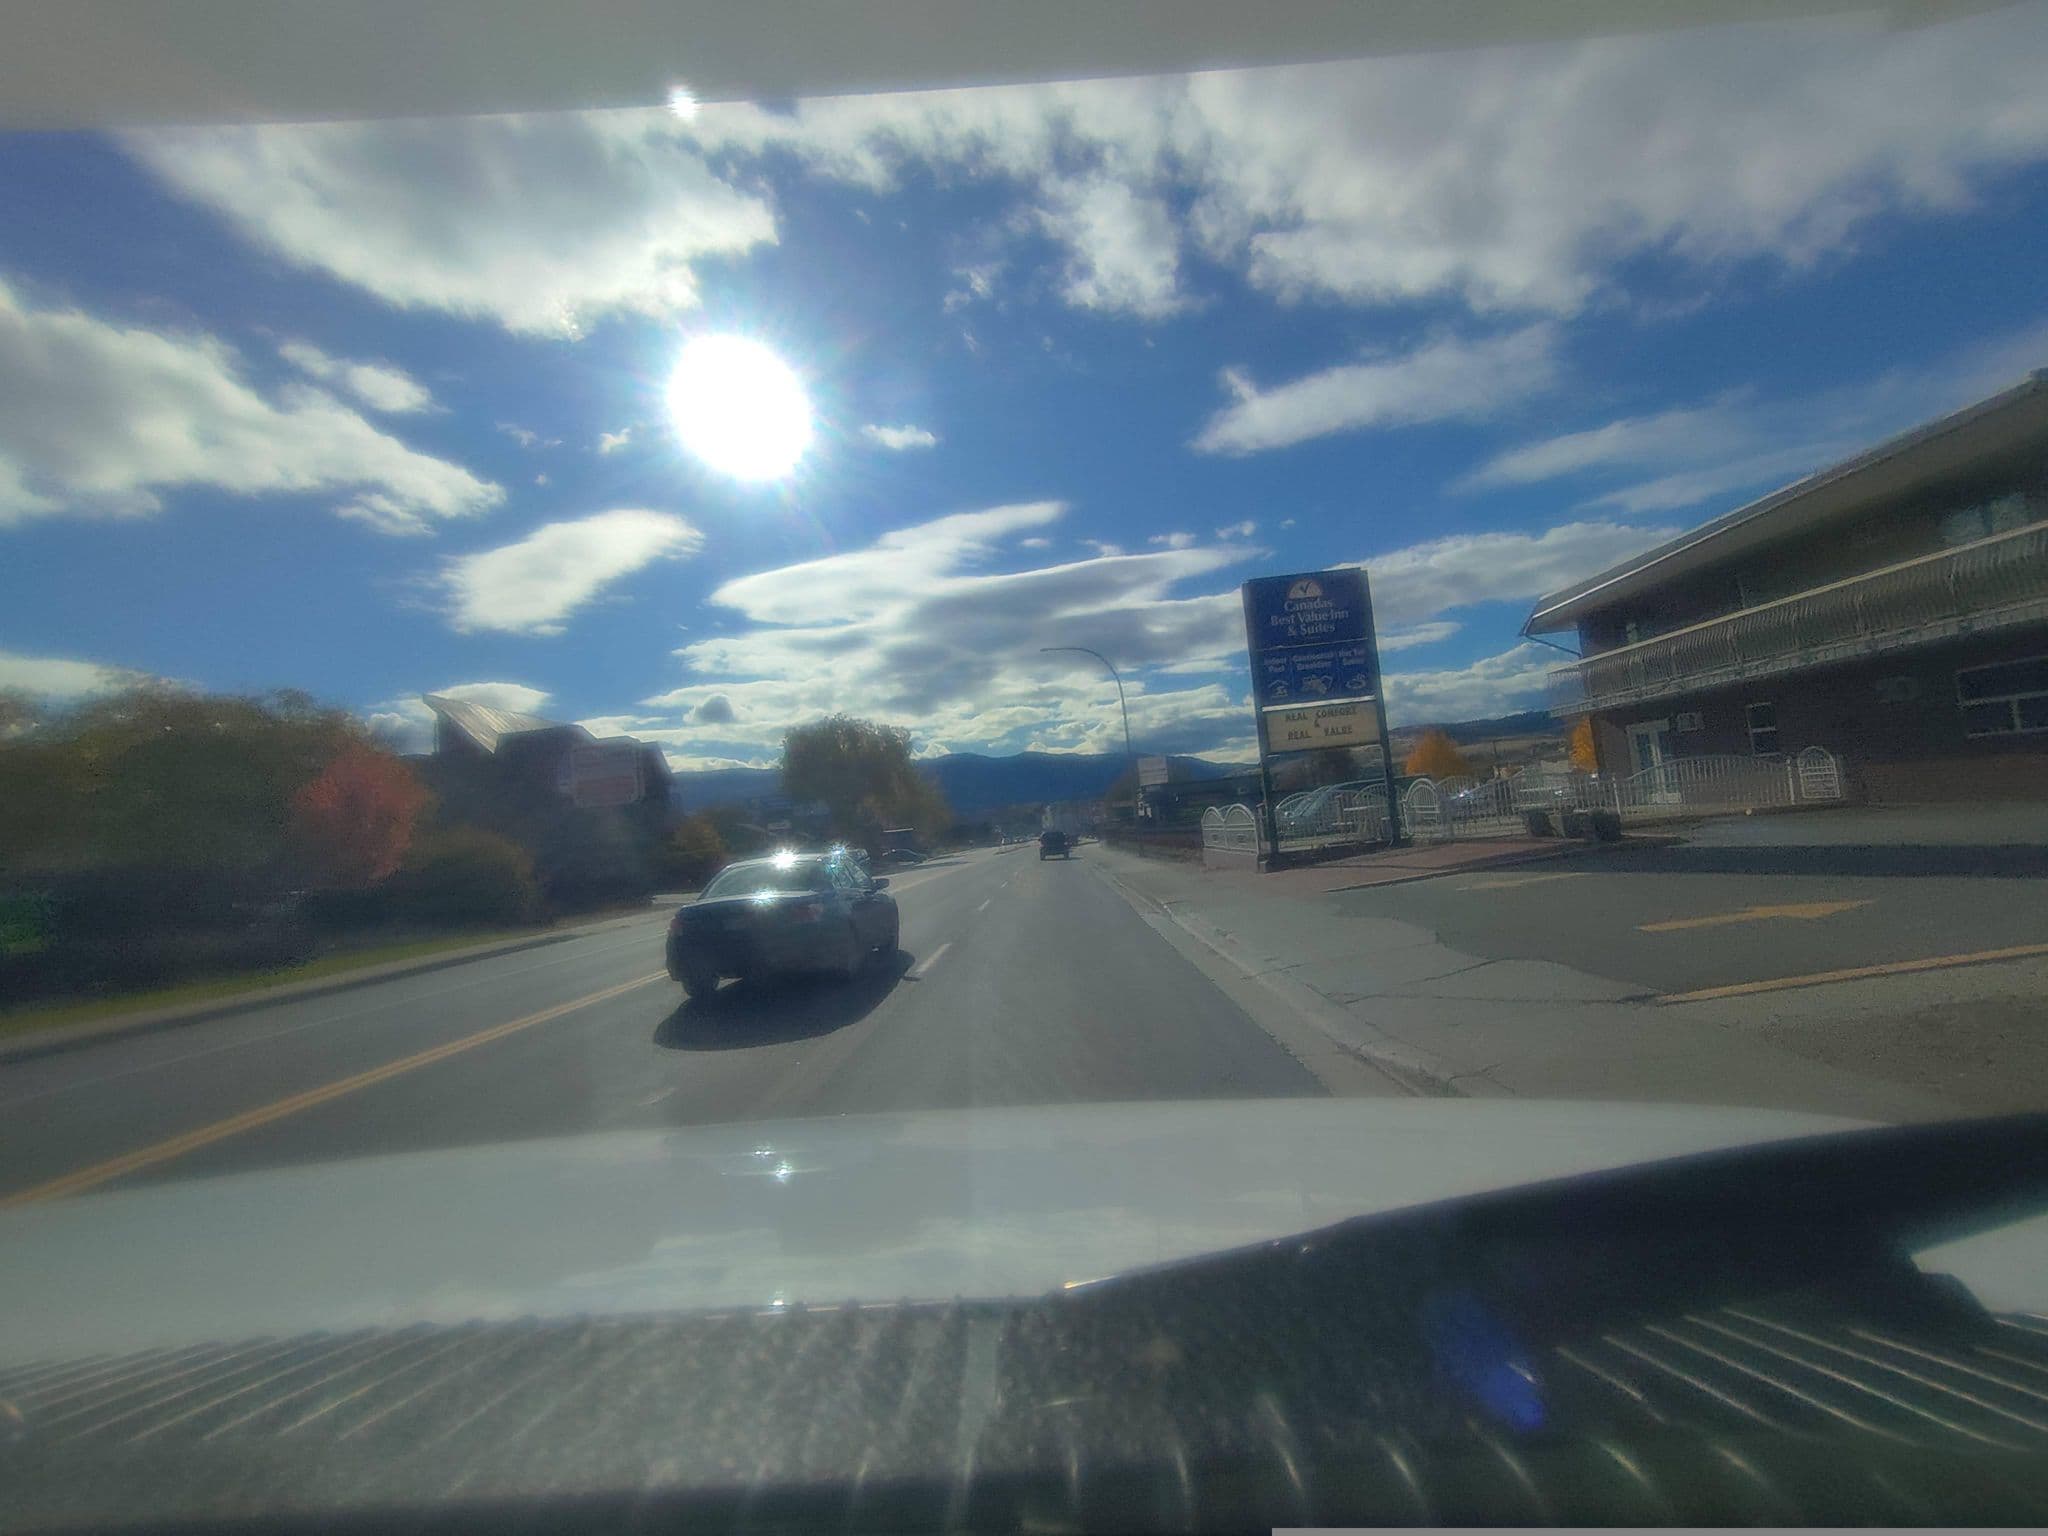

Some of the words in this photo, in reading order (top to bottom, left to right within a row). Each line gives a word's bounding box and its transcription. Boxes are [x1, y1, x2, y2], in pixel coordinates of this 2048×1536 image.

[1270, 613, 1295, 627] Best
[1297, 610, 1329, 623] Value
[1329, 608, 1349, 620] Inn
[1287, 624, 1297, 636] &
[1299, 623, 1336, 636] Suites
[1287, 730, 1312, 740] REAL
